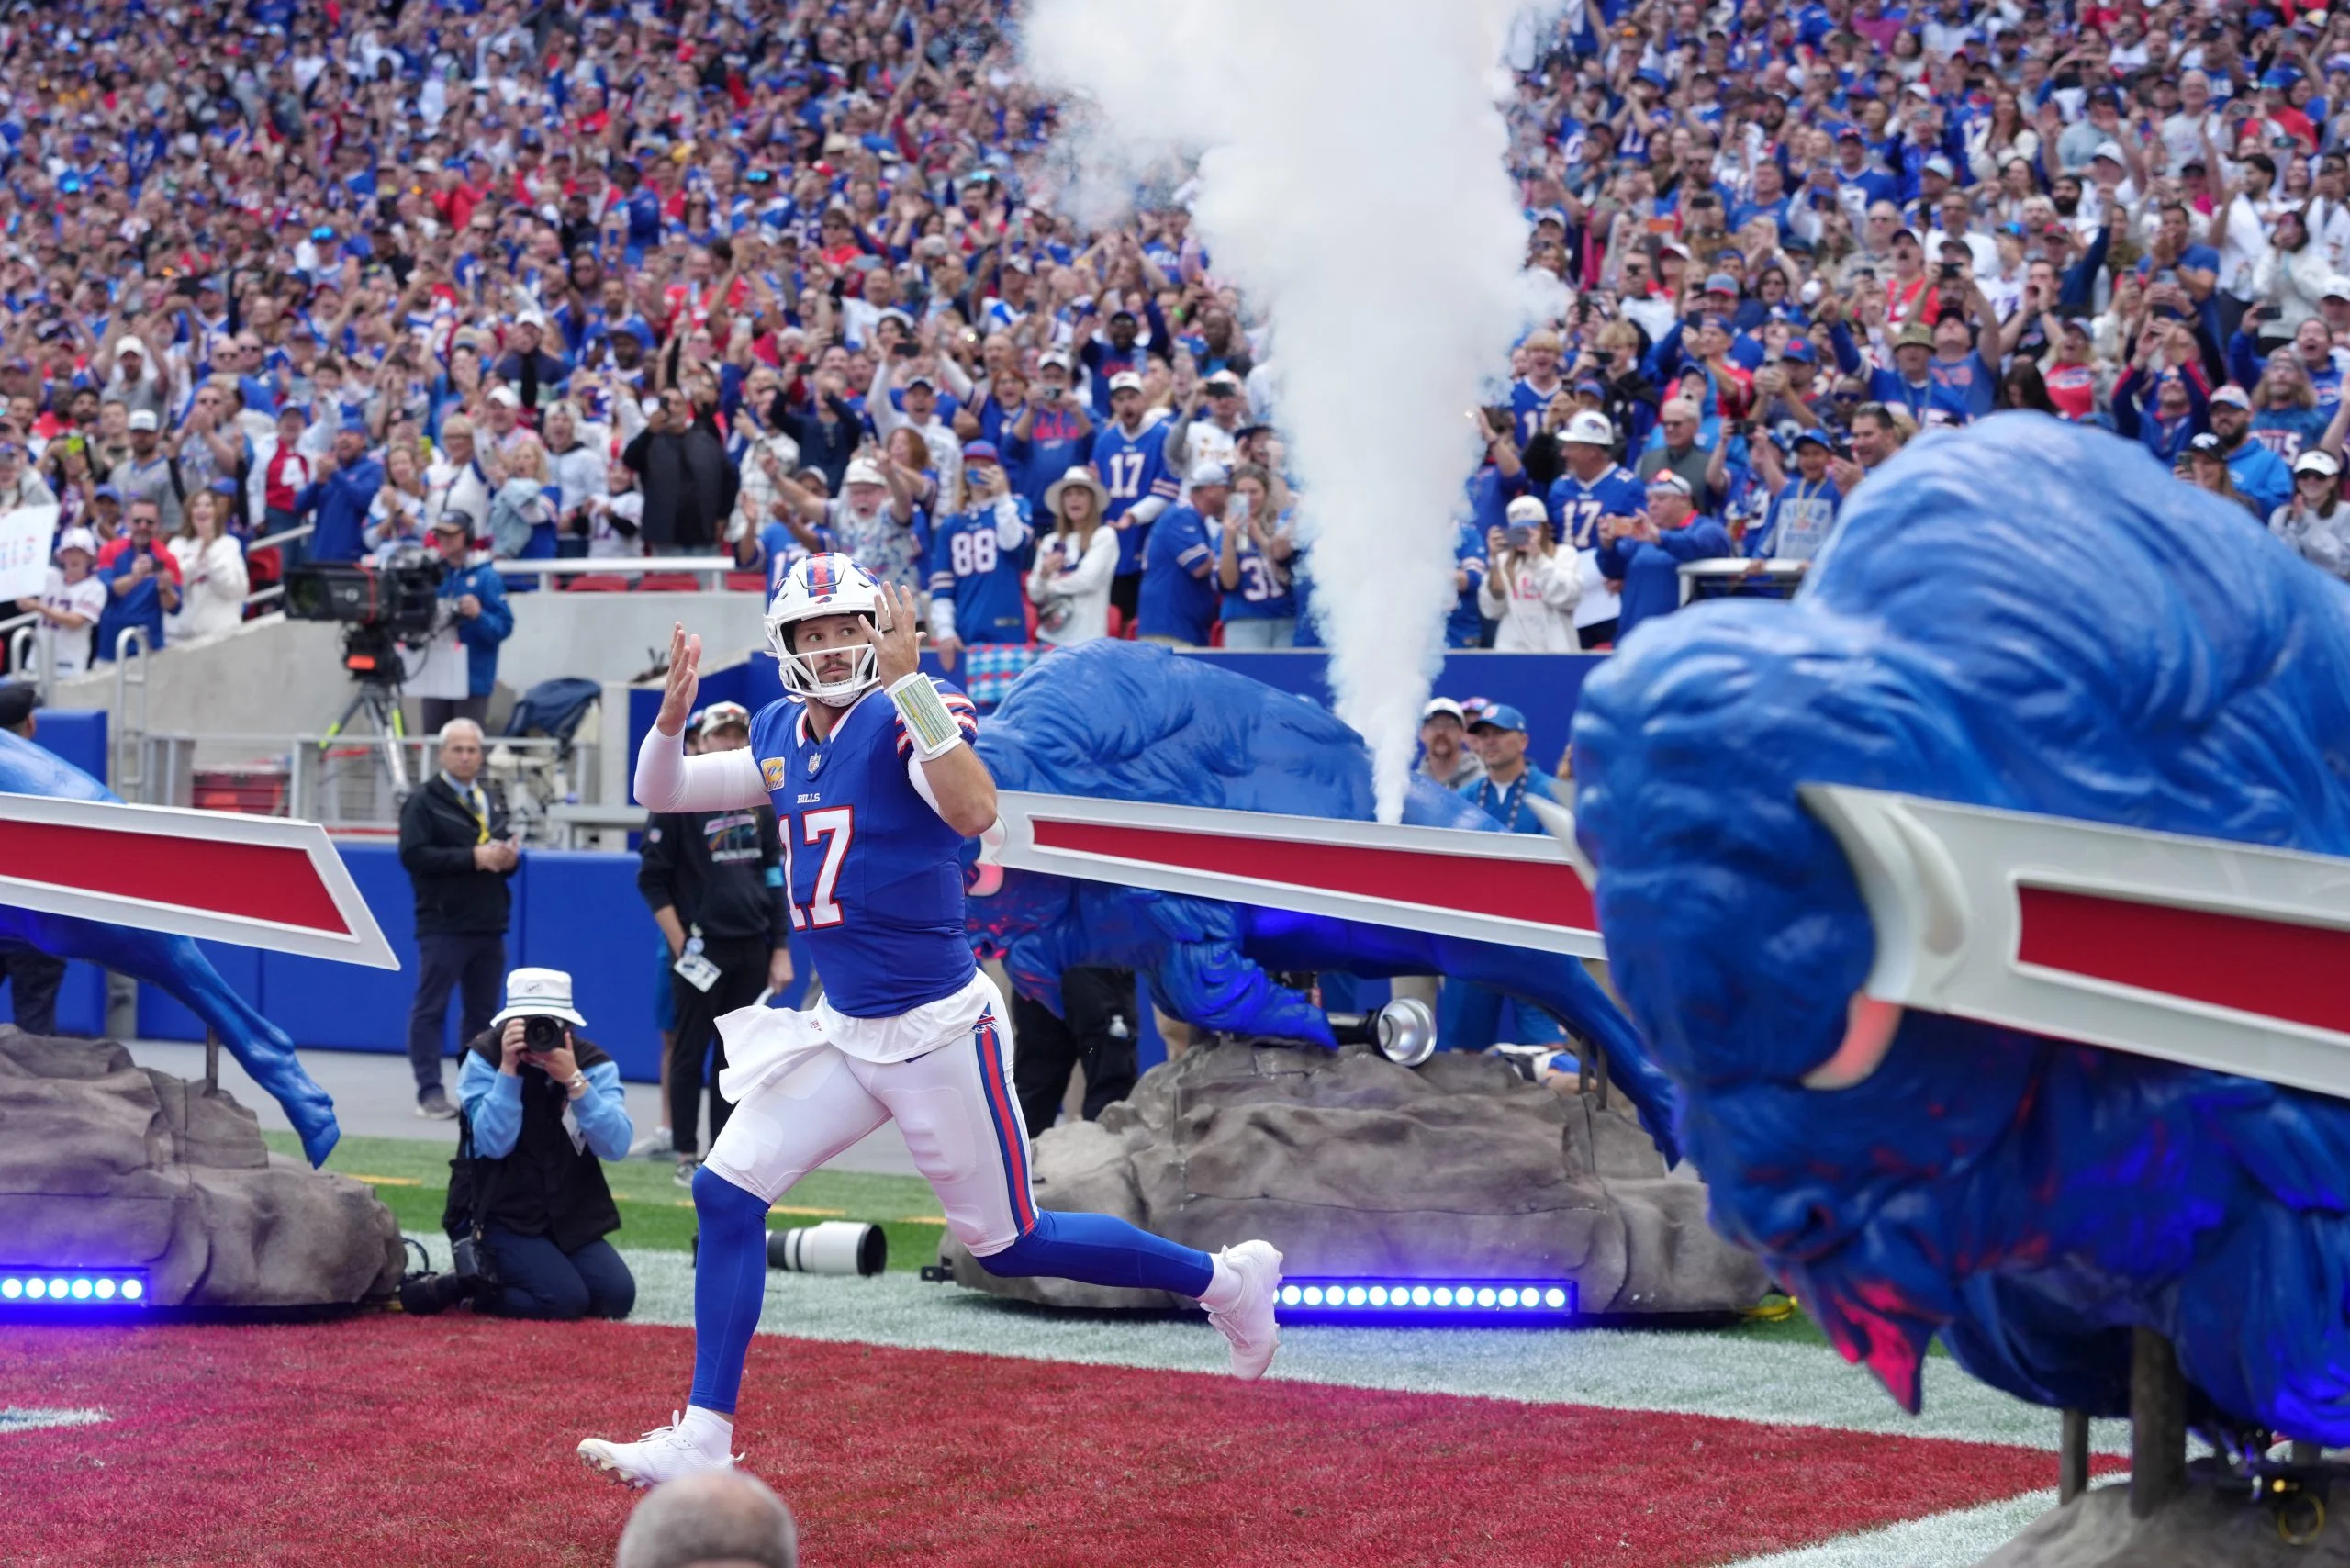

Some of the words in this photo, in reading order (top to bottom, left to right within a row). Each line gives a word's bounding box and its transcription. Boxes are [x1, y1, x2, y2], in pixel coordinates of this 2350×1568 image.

[1108, 453, 1146, 498] 17
[1562, 499, 1603, 548] 17
[951, 528, 998, 577] 88
[797, 792, 821, 804] BILLS
[778, 804, 854, 932] 17
